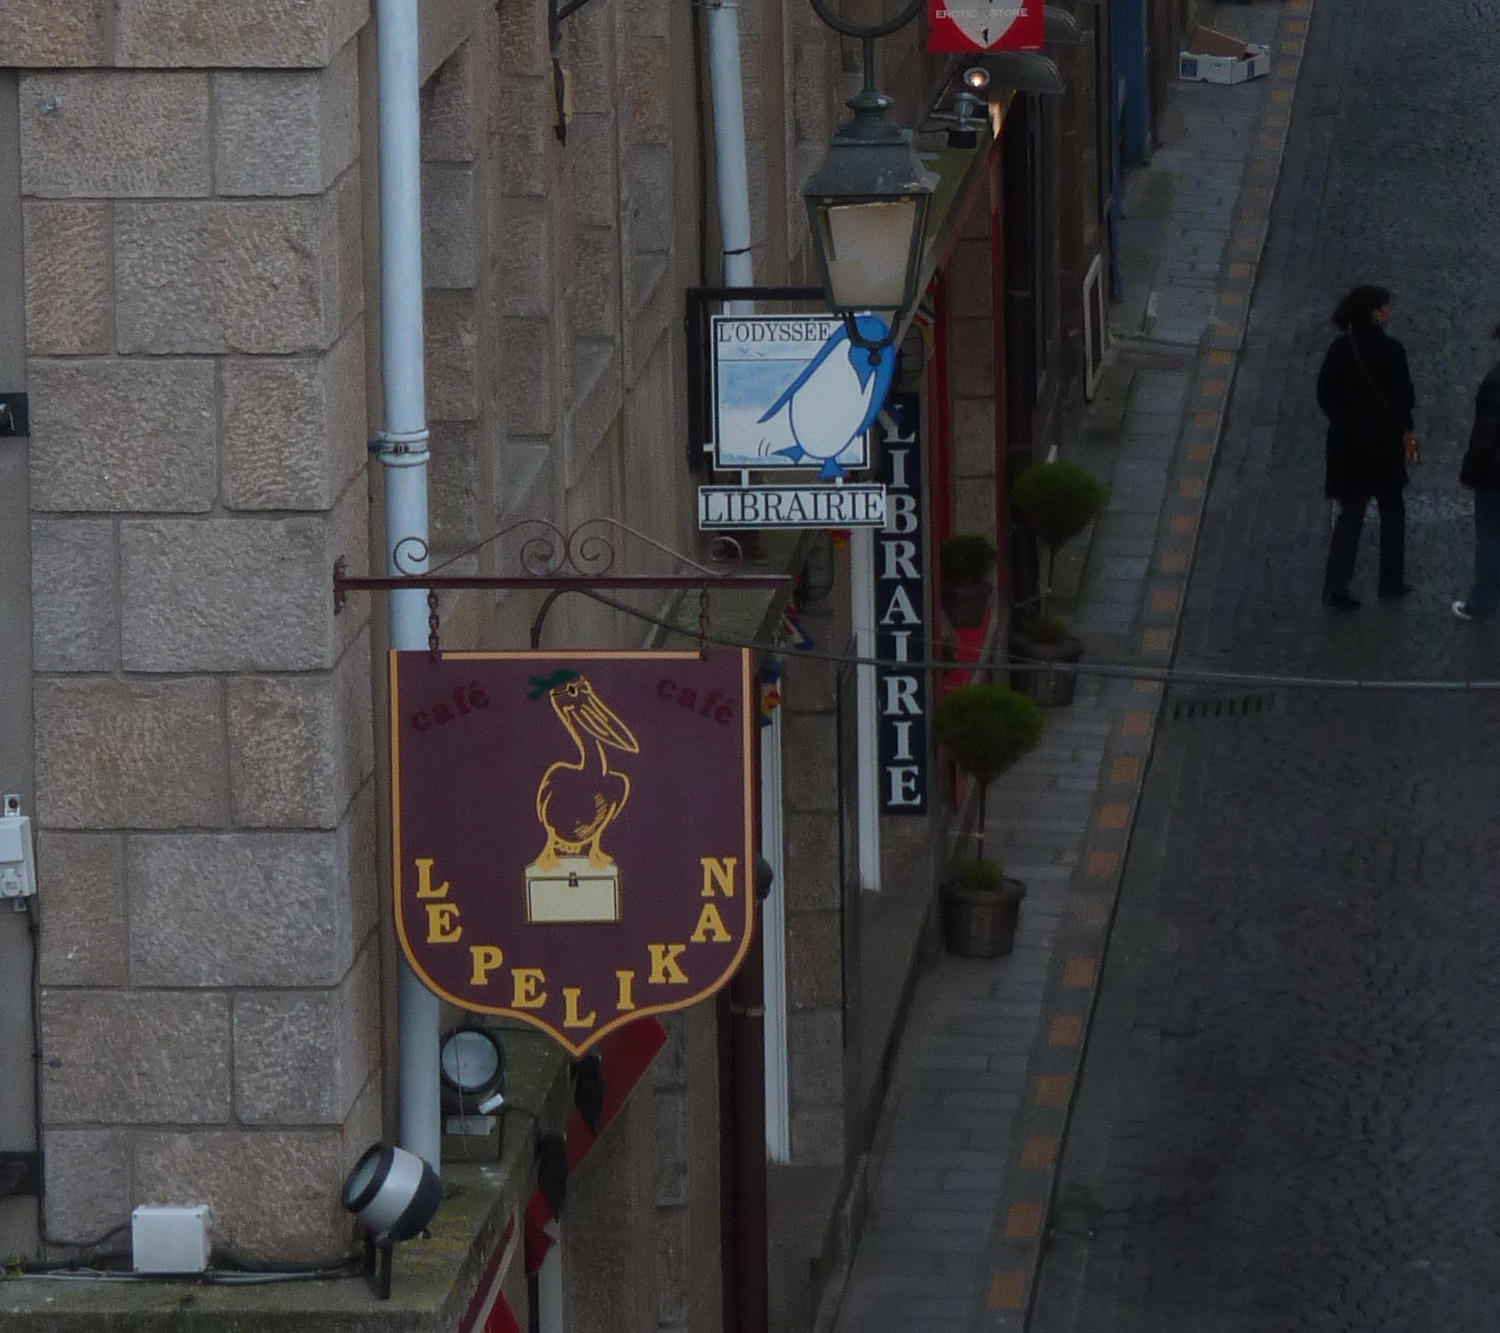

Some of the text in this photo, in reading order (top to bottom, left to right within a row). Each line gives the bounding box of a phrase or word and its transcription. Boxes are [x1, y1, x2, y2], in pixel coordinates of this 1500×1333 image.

[935, 7, 1029, 19] EROTIC STORE
[718, 318, 832, 342] L'ODYSSÉE
[702, 491, 884, 523] LIBRAIRIE
[877, 404, 923, 806] LIBRAIRIE
[410, 677, 735, 732] café café
[415, 857, 738, 1028] LE PELIKAN
